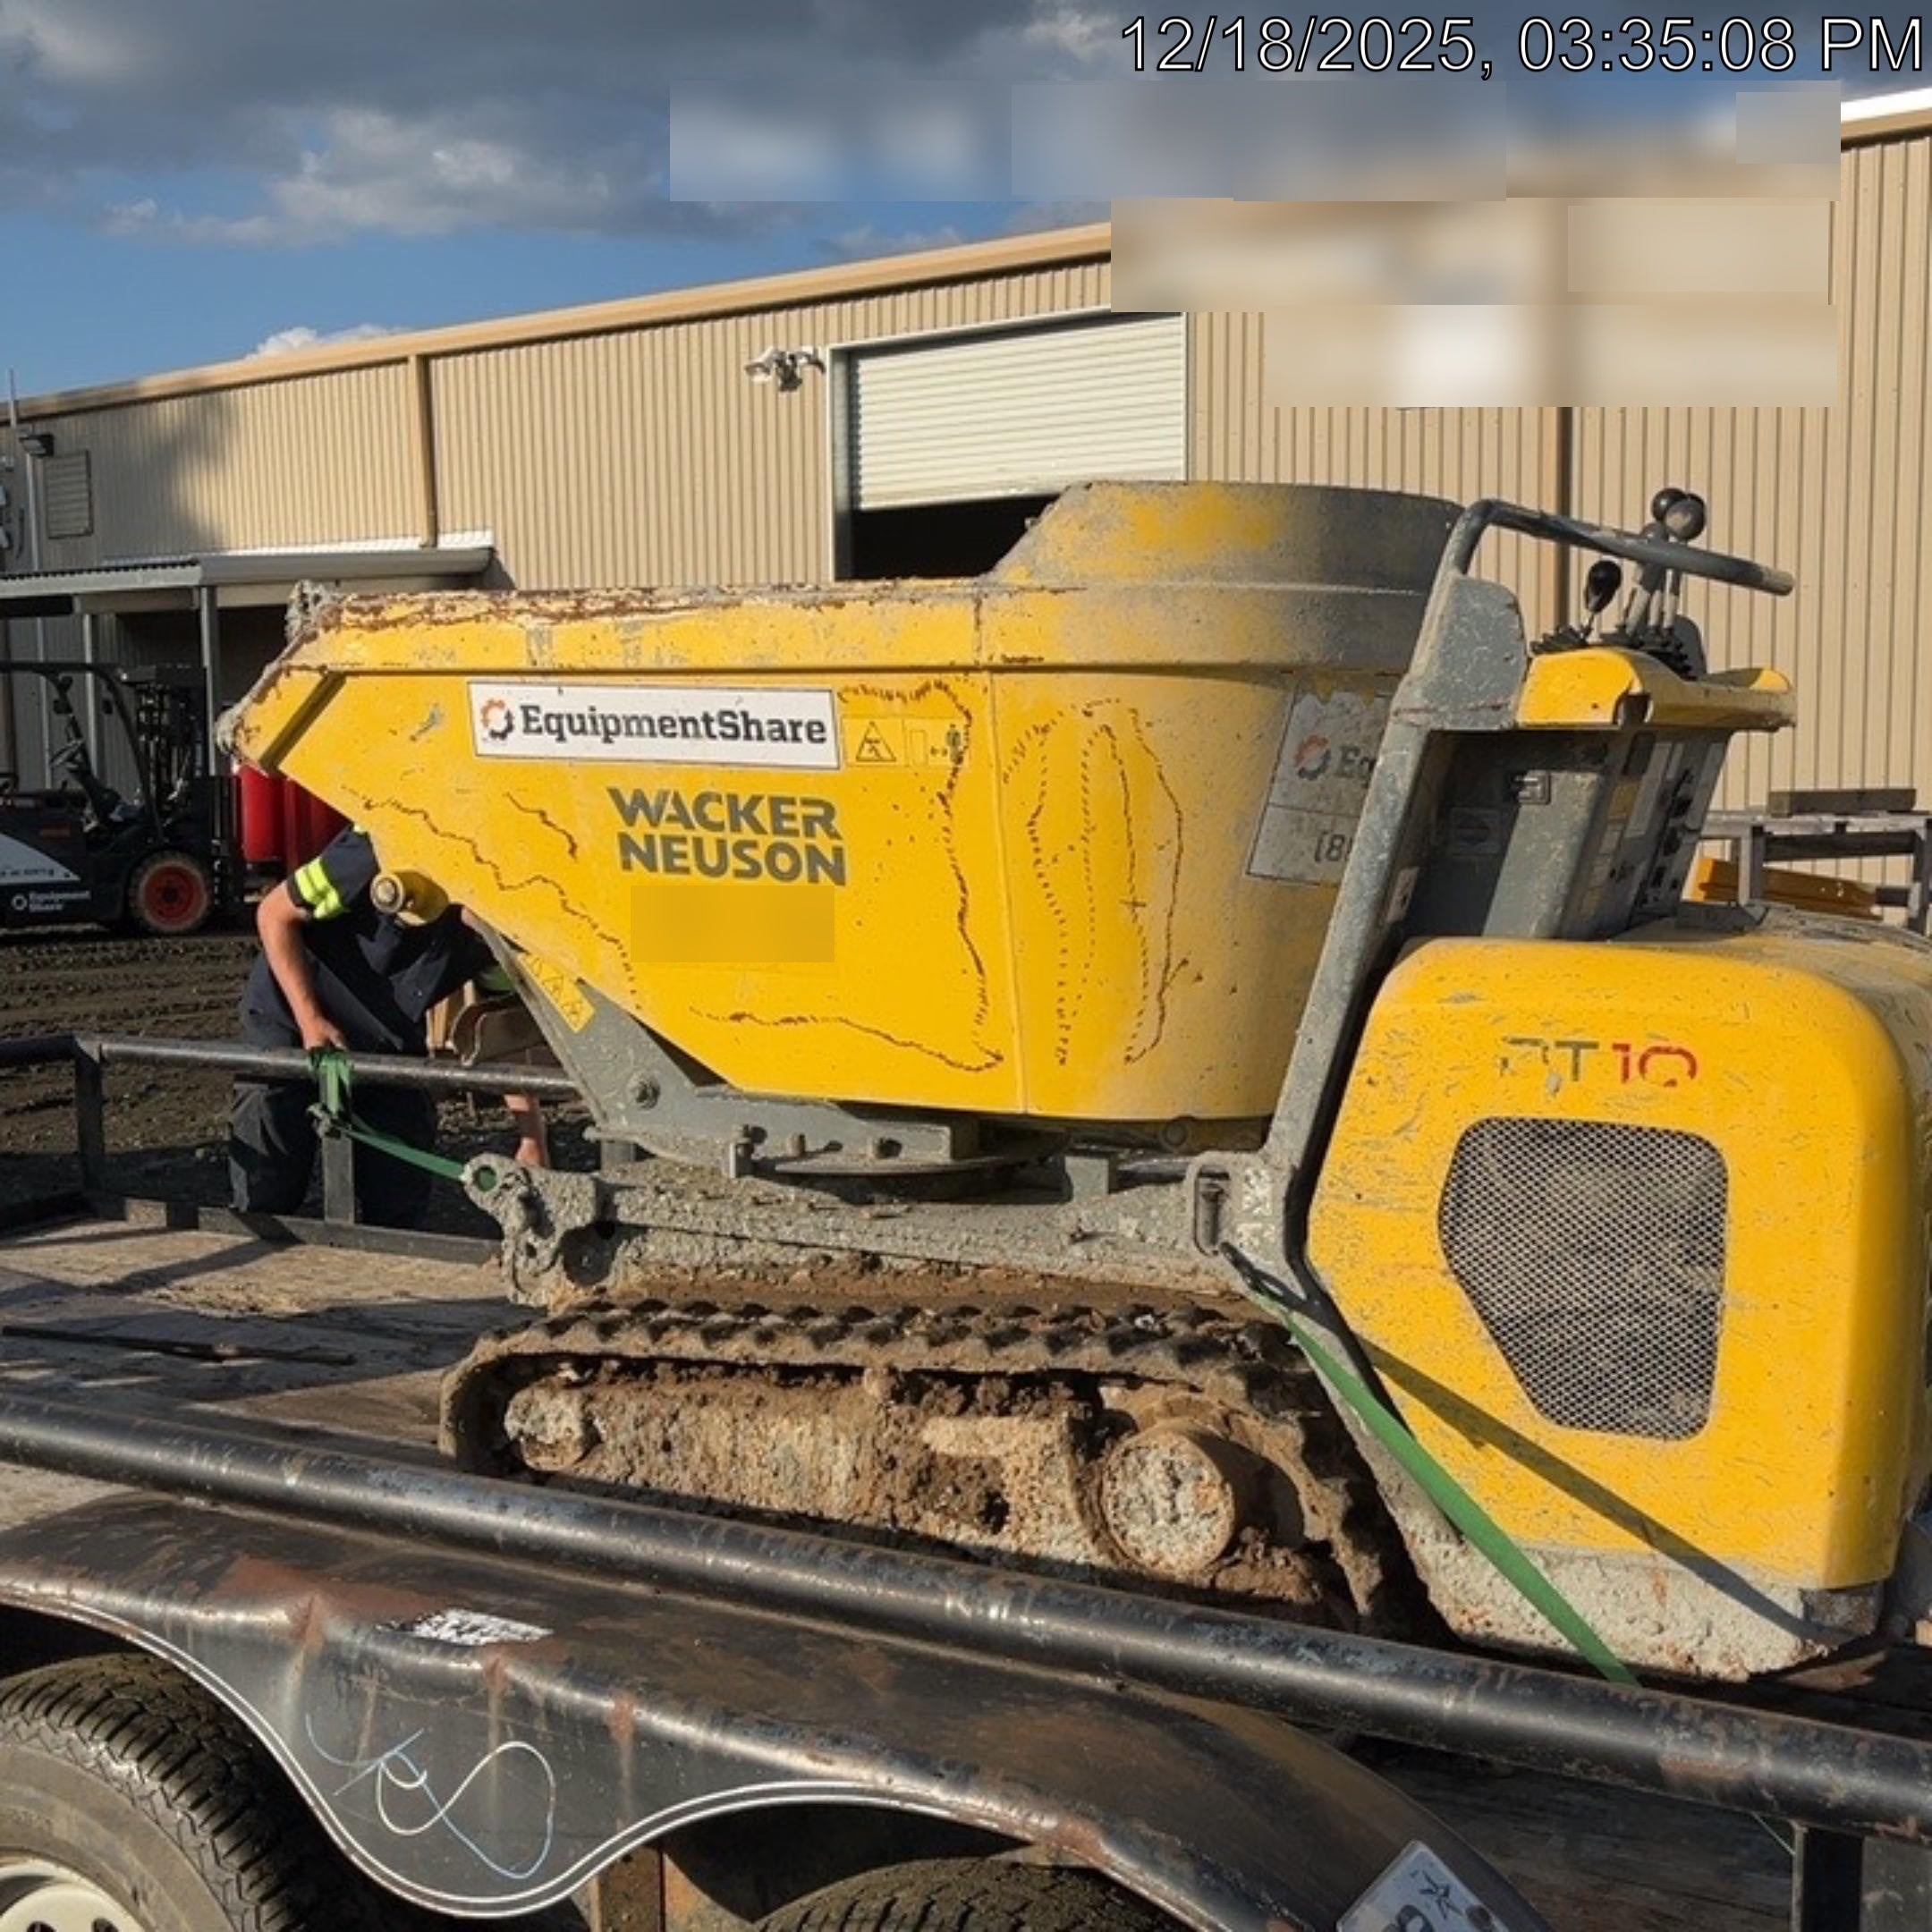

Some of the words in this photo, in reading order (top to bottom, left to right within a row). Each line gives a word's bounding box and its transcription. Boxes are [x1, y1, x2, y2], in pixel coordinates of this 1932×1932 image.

[520, 705, 827, 743] EquipmentShare
[606, 787, 843, 841] WACKER
[617, 832, 846, 886] NEUSON
